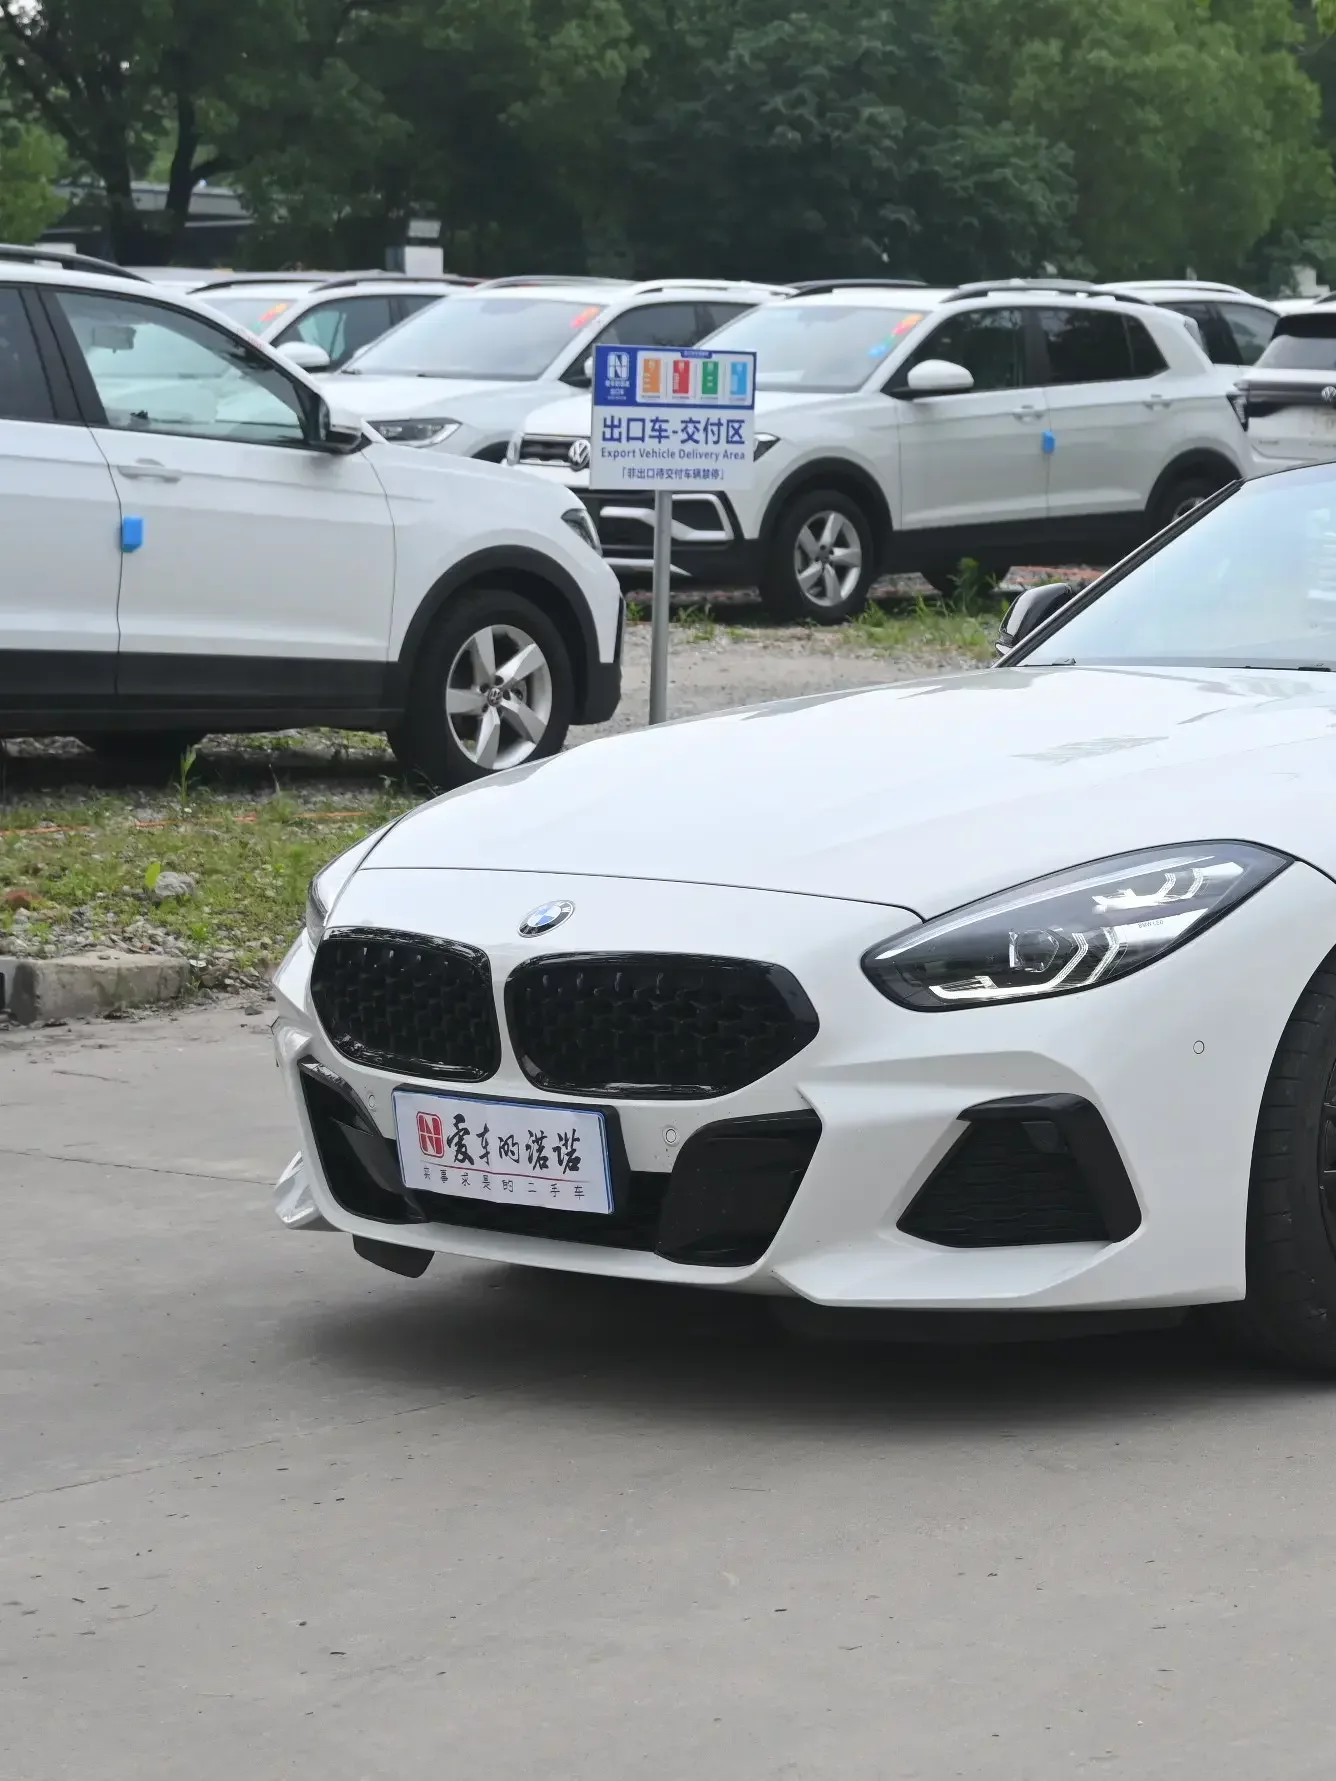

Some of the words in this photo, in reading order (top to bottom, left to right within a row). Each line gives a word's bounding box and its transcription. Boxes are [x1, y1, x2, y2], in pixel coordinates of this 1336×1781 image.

[601, 415, 746, 445] 出口车-交付区
[601, 447, 636, 461] Export
[639, 448, 676, 459] Vehicle
[678, 449, 720, 464] Delivery
[722, 449, 745, 460] Area
